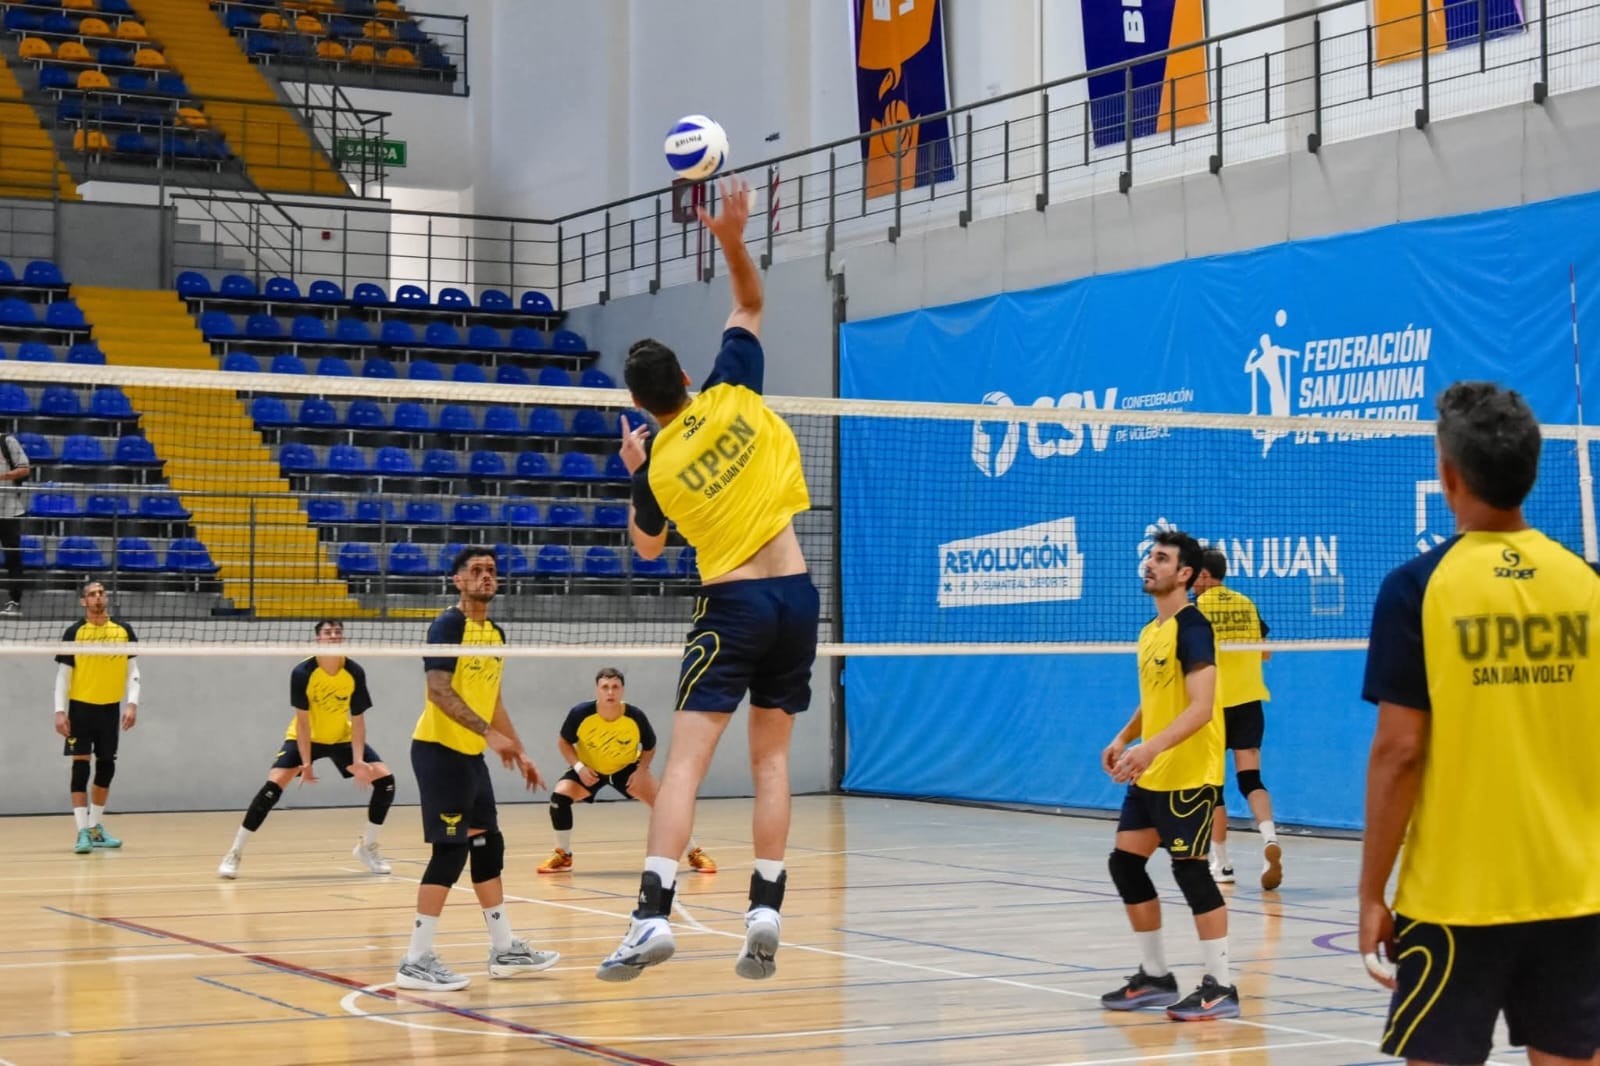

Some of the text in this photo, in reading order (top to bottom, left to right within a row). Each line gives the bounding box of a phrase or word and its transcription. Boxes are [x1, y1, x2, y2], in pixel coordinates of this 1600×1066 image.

[1302, 323, 1432, 372] FEDERACIÓN
[1121, 387, 1194, 409] CONFEDERACIÓN
[1298, 366, 1425, 408] SANJUANINA
[1027, 387, 1118, 459] CSV
[676, 414, 756, 492] UPCN
[703, 481, 723, 499] SAN
[719, 464, 740, 486] JUAN
[944, 534, 1069, 574] REVOLUCIÓN
[1197, 535, 1338, 578] AN JUAN
[1453, 612, 1590, 662] UPCN
[1472, 664, 1575, 686] SAN JUAN VOLEY
